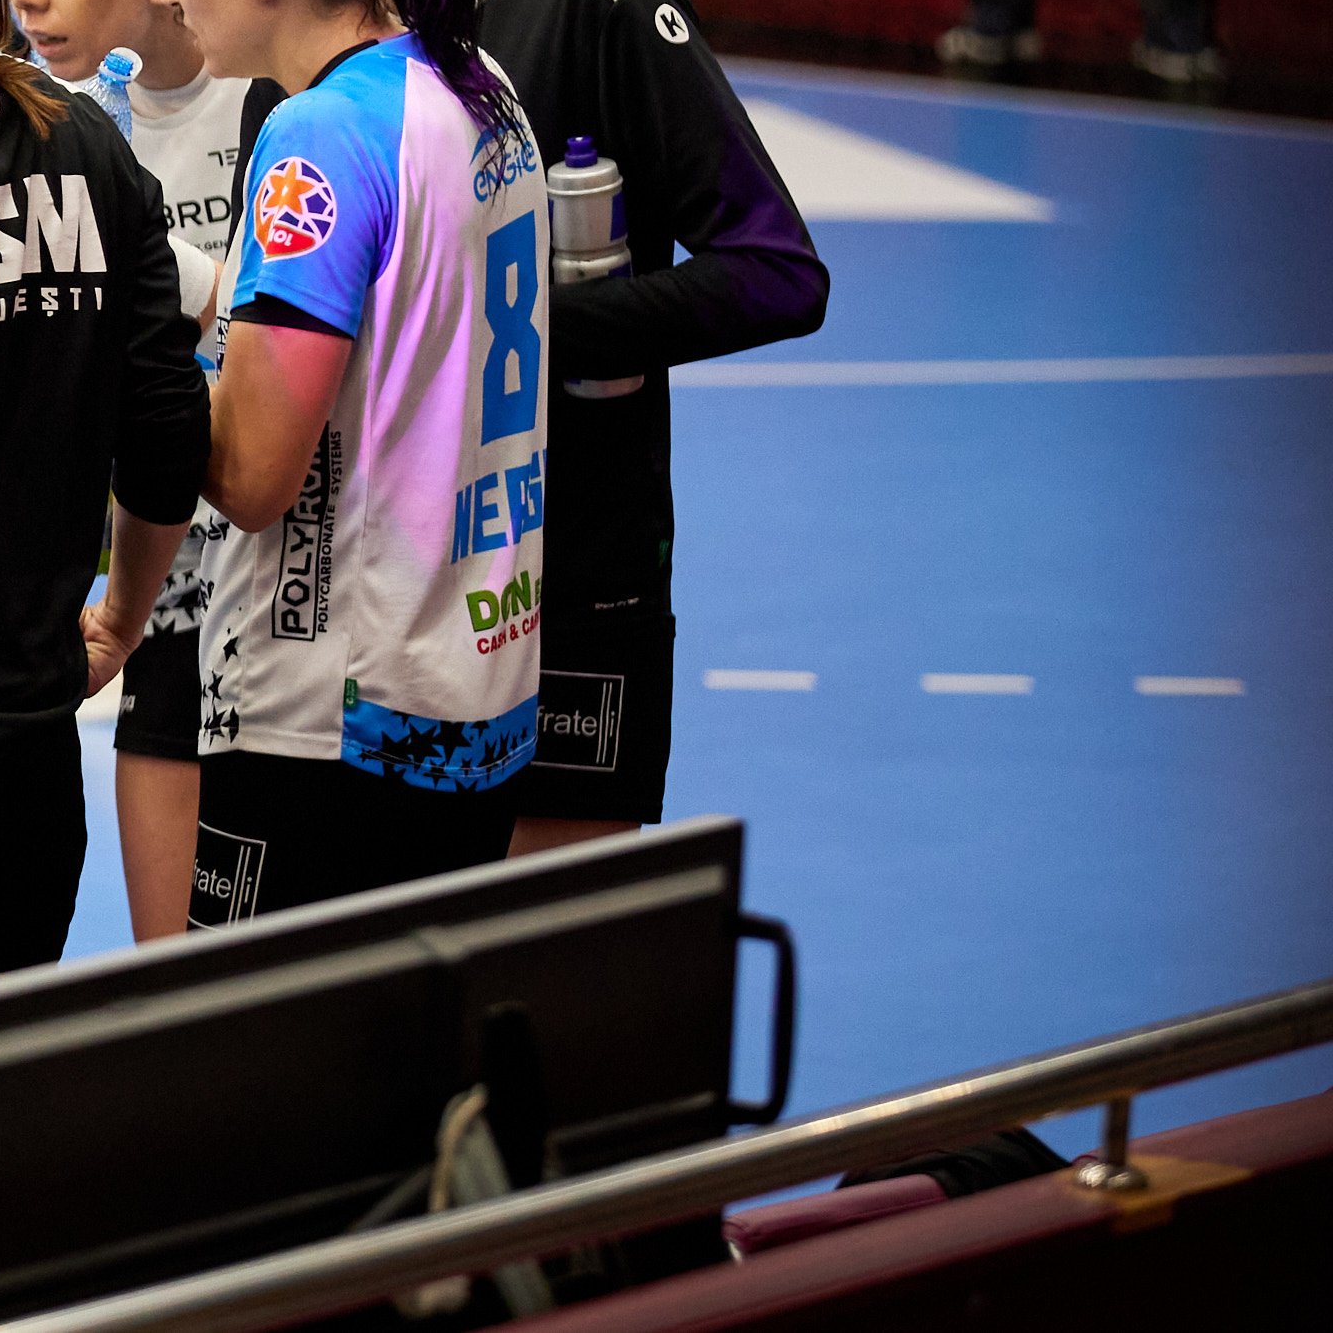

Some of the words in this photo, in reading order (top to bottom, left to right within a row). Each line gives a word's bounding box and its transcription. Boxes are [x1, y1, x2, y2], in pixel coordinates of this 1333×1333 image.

[481, 210, 541, 448] 8
[317, 504, 336, 634] POLYCARBONATE
[330, 431, 342, 496] SYSTEMS
[509, 623, 520, 641] &
